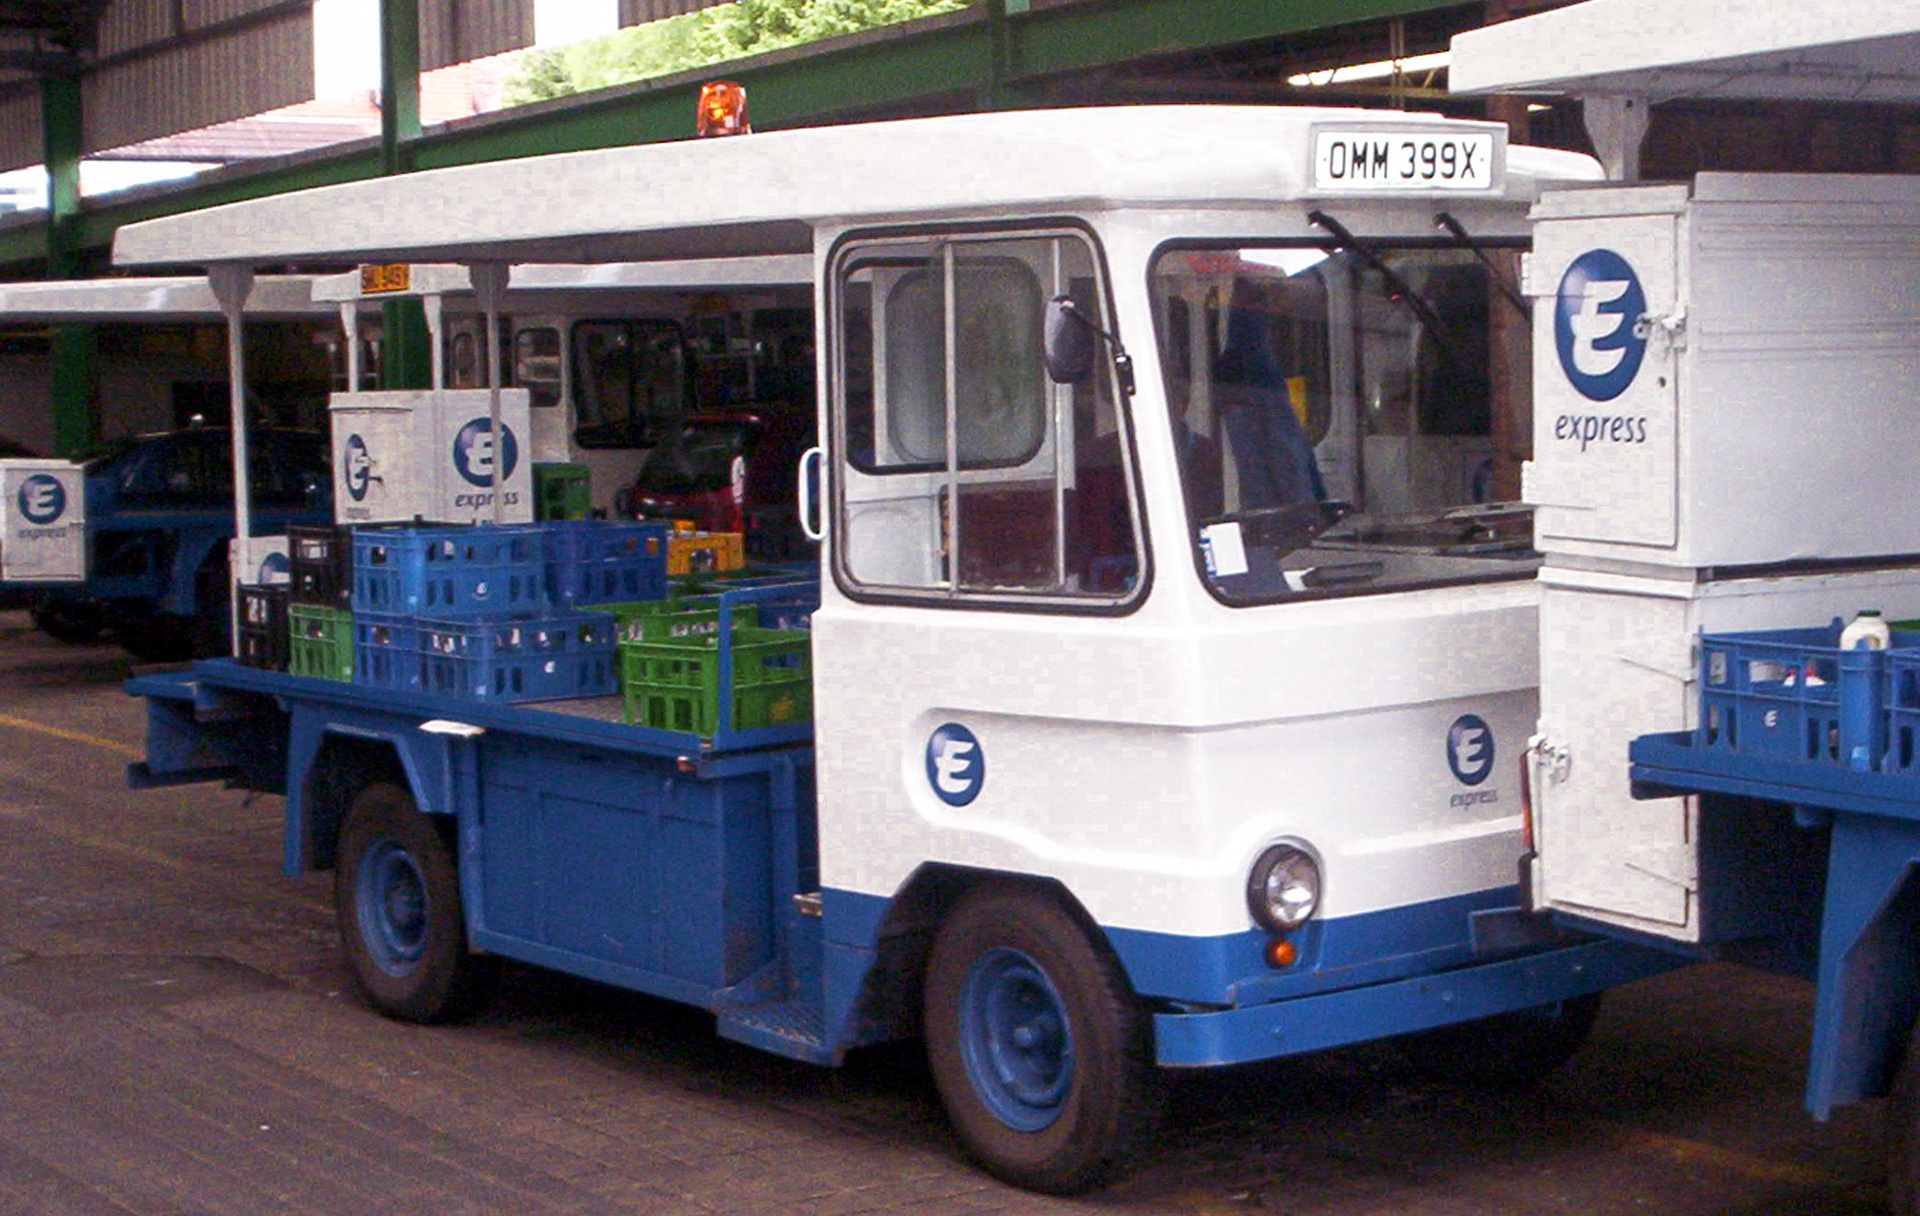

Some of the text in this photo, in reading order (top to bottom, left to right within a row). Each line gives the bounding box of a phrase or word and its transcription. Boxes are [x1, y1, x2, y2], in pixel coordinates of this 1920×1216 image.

[1329, 140, 1478, 180] OMM 399X
[1554, 413, 1648, 452] express
[455, 491, 519, 511] exprss
